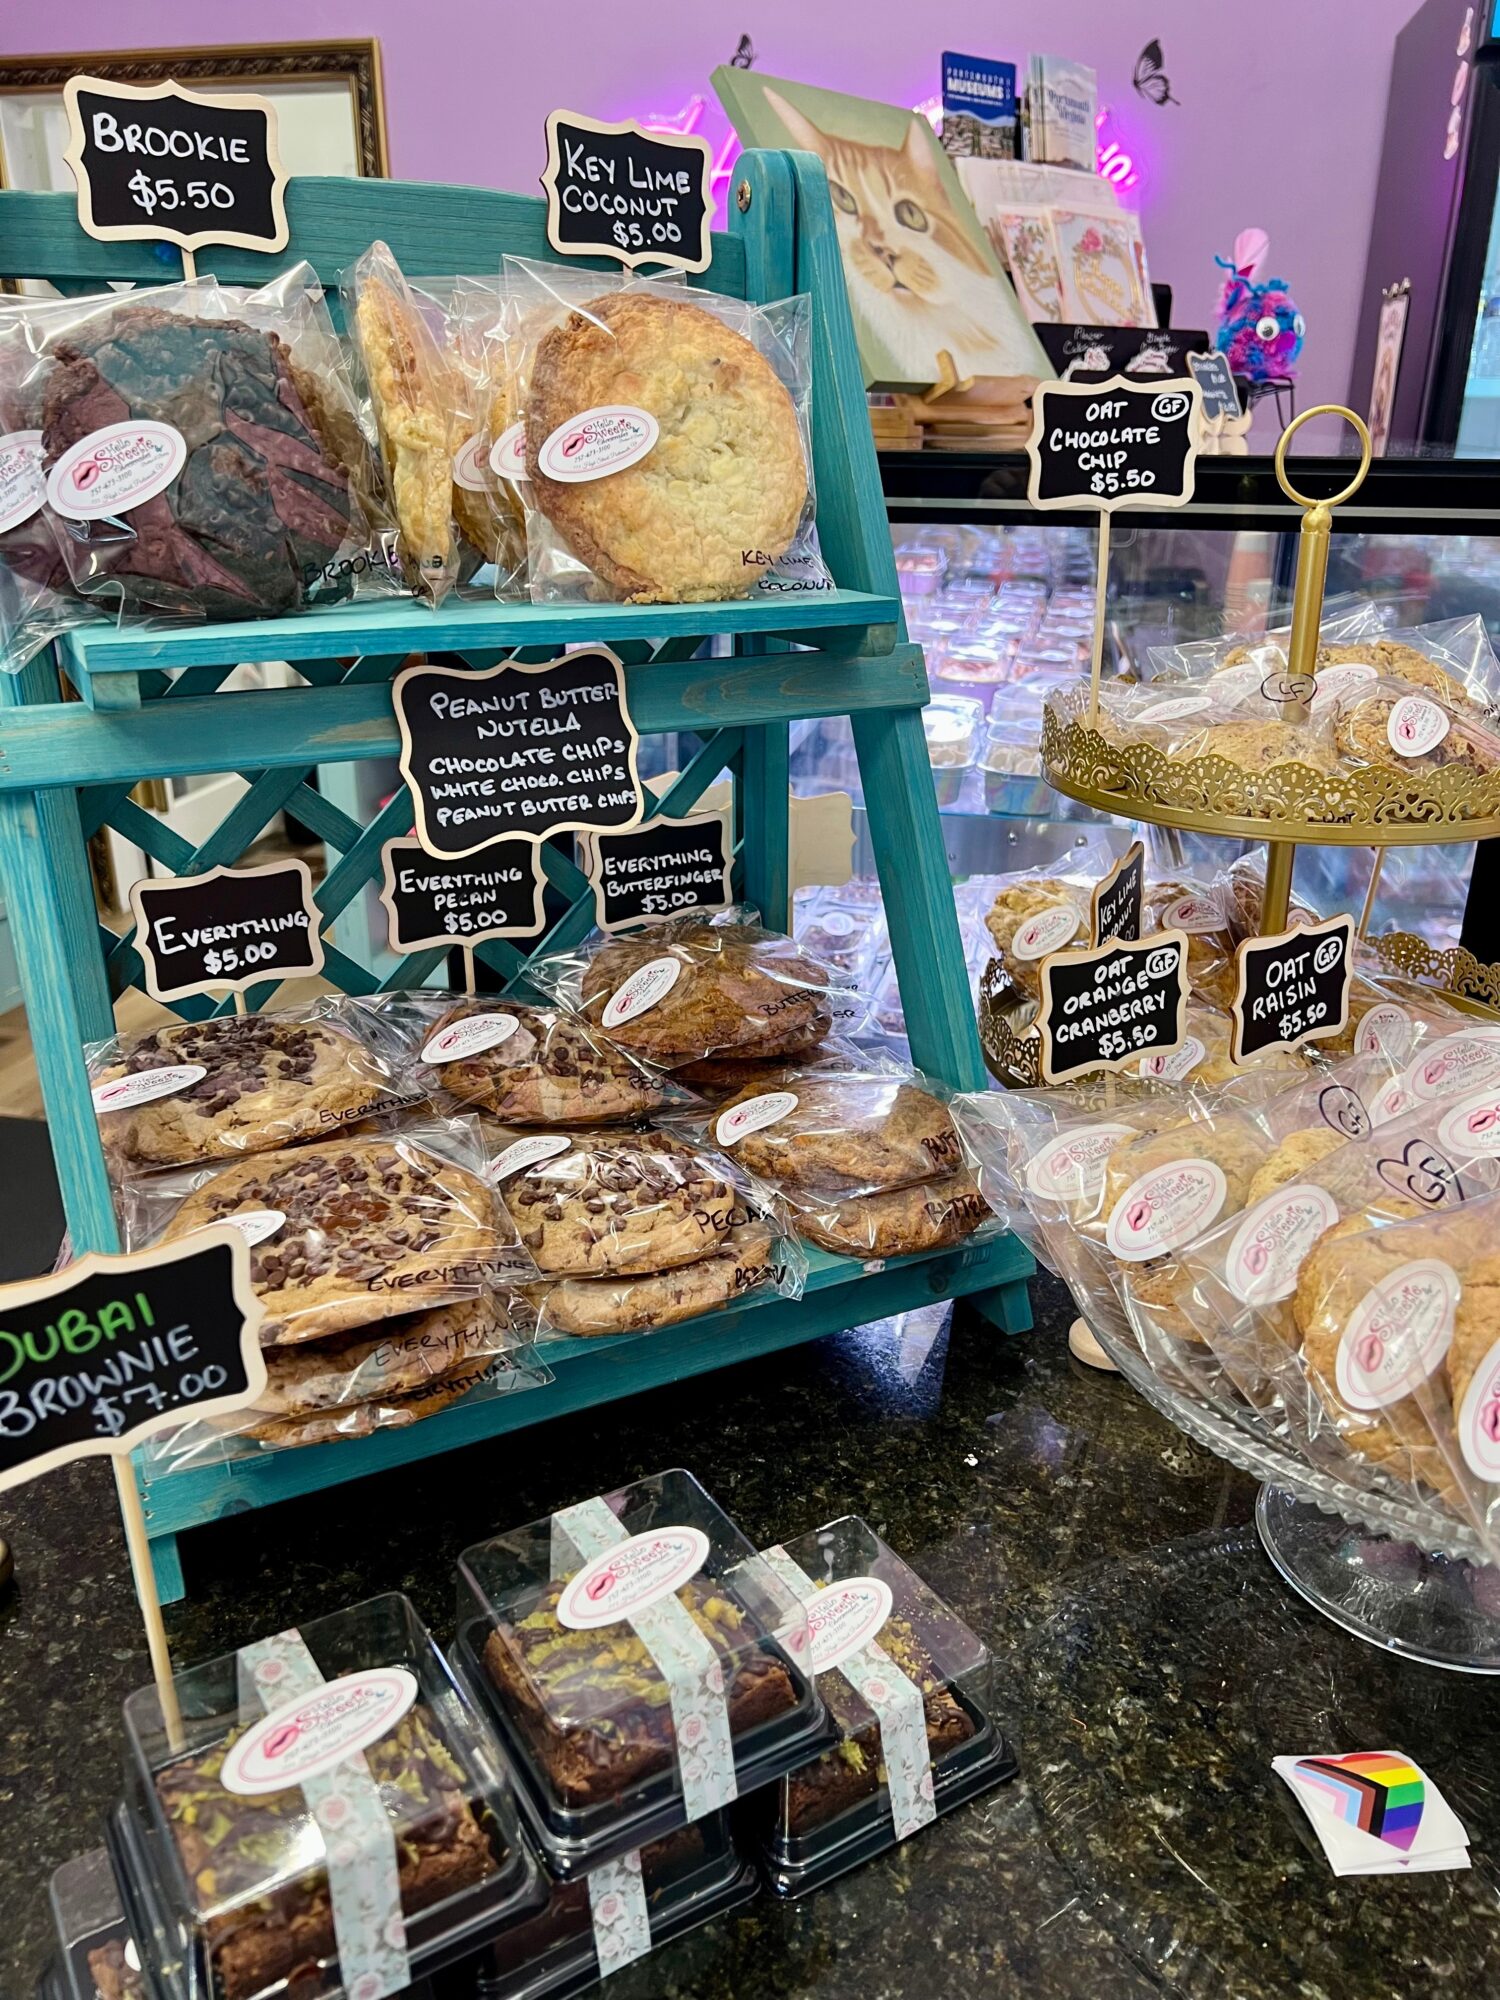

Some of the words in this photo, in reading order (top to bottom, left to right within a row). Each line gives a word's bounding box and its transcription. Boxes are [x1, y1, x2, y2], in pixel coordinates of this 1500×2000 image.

[947, 77, 1003, 99] MUSEUMS
[93, 113, 250, 163] BROOKIE
[564, 138, 616, 185] KEY
[628, 156, 691, 196] LIME
[128, 169, 235, 215] $5.50
[562, 184, 679, 217] COCONUT
[612, 220, 682, 248] $5.00
[593, 416, 613, 430] Hello
[1085, 401, 1129, 422] OAT
[104, 436, 131, 455] Hello
[583, 415, 633, 444] Sweetie
[1050, 426, 1161, 451] CHOCOLATE
[95, 436, 154, 471] Sweetie
[1077, 451, 1128, 471] CHIP
[1090, 469, 1156, 494] $5.50
[742, 550, 774, 566] KEY
[429, 691, 530, 720] PEANUT
[538, 682, 619, 710] BUTTER
[476, 712, 582, 740] NUTELLA
[429, 747, 557, 775] CHOCOLATE
[561, 736, 626, 762] CHIPS
[430, 779, 497, 800] WHITE
[500, 775, 564, 793] CHOCO.
[566, 764, 626, 785] CHIPS
[436, 801, 516, 828] PEANUT
[521, 794, 593, 817] BUTTER
[597, 789, 638, 808] CHIPS
[604, 849, 713, 875] EVERYTHING
[399, 867, 523, 894] EVERYTHING
[607, 868, 723, 897] BUTTERFINGER
[434, 889, 497, 911] PECAN
[641, 891, 698, 914] $5.00
[1101, 899, 1116, 933] KEY
[1118, 869, 1137, 908] LIME
[153, 910, 310, 955] EVERYTHING
[443, 910, 508, 934] $5.00
[202, 941, 278, 975] $5.00
[1095, 955, 1133, 983] OAT
[1265, 952, 1311, 988] OAT
[1063, 970, 1149, 1015] ORANGE
[1252, 976, 1317, 1021] RAISIN
[1056, 990, 1166, 1043] CRANBERRY
[1279, 1002, 1327, 1039] $5.50
[1451, 1042, 1476, 1057] Hello
[1145, 1171, 1194, 1209] Sweetie
[1150, 1173, 1175, 1195] Hello
[1407, 1156, 1451, 1203] GF
[1257, 1203, 1307, 1248] Sweetie
[1264, 1210, 1285, 1231] Hello
[367, 1260, 526, 1292] EVERYTHING
[1370, 1283, 1422, 1338] Sweetie
[1374, 1294, 1400, 1323] Hello
[375, 1320, 530, 1367] EVERYTHING
[0, 1323, 199, 1437] BROWNIE
[92, 1364, 228, 1437] $7.00
[610, 1540, 672, 1578] Sweetie
[619, 1543, 646, 1564] Hello
[808, 1591, 860, 1630] Sweetie
[814, 1595, 838, 1615] Hello
[297, 1687, 375, 1730] Sweetie
[313, 1693, 344, 1713] Hello
